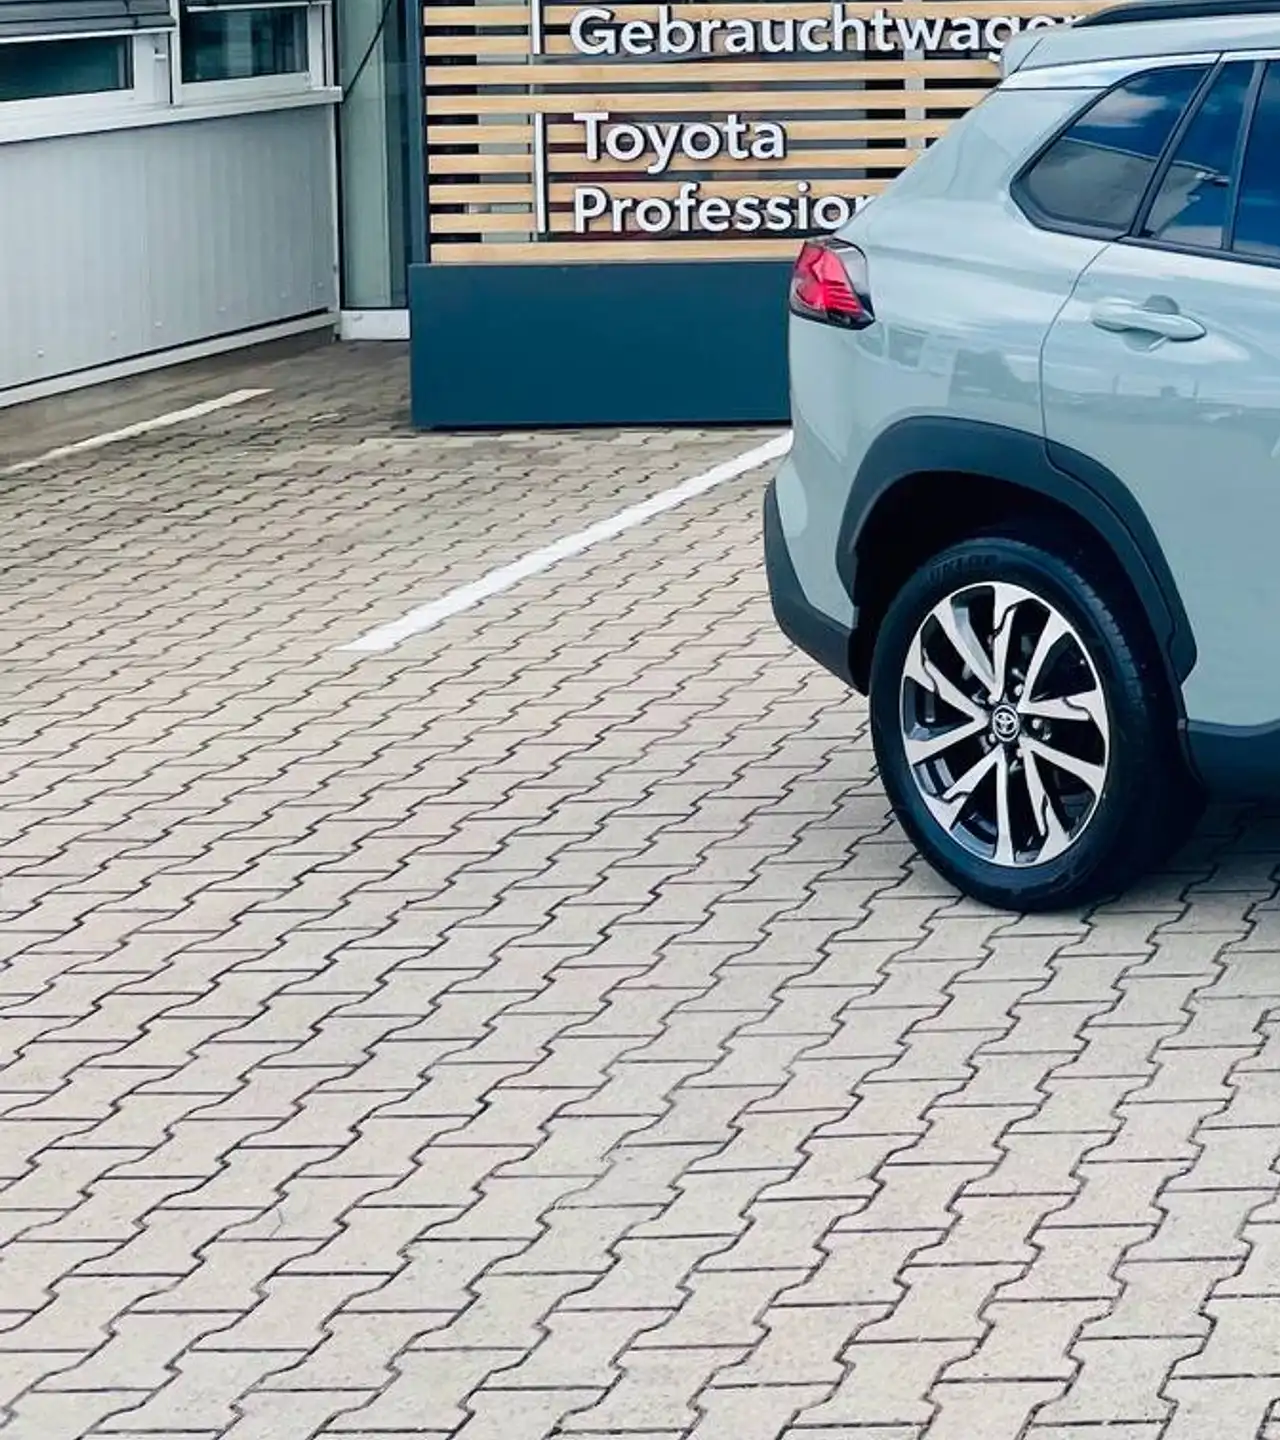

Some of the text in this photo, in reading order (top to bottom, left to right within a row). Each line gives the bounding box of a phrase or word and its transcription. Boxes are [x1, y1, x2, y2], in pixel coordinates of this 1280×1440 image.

[570, 4, 1087, 63] Gebrauchtwag
[573, 111, 786, 174] Toyota
[574, 181, 876, 234] Professio
